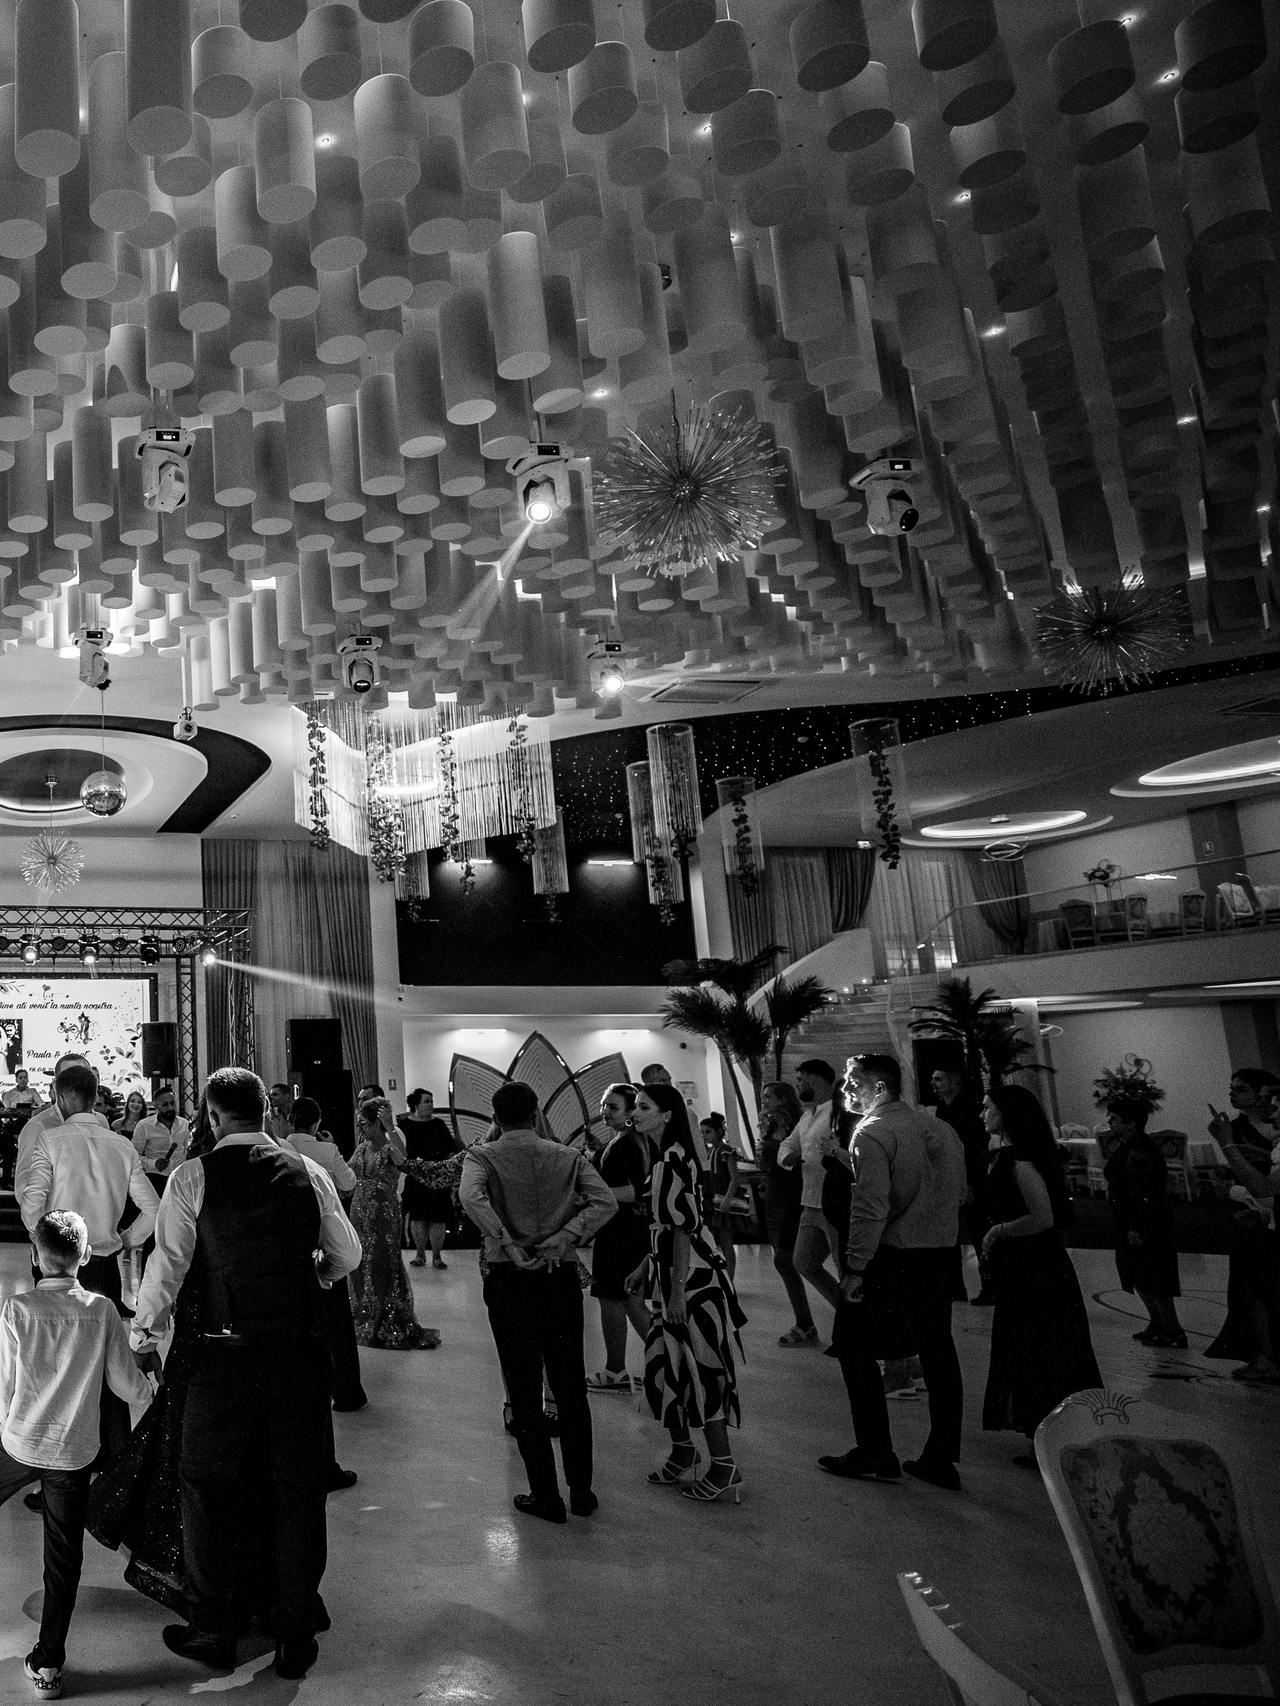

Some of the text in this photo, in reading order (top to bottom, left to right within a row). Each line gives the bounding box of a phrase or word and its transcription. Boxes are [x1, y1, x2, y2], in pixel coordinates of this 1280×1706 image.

[29, 1001, 51, 1009] venit
[50, 1001, 58, 1009] la
[26, 1049, 52, 1058] Paula
[54, 1050, 61, 1058] &
